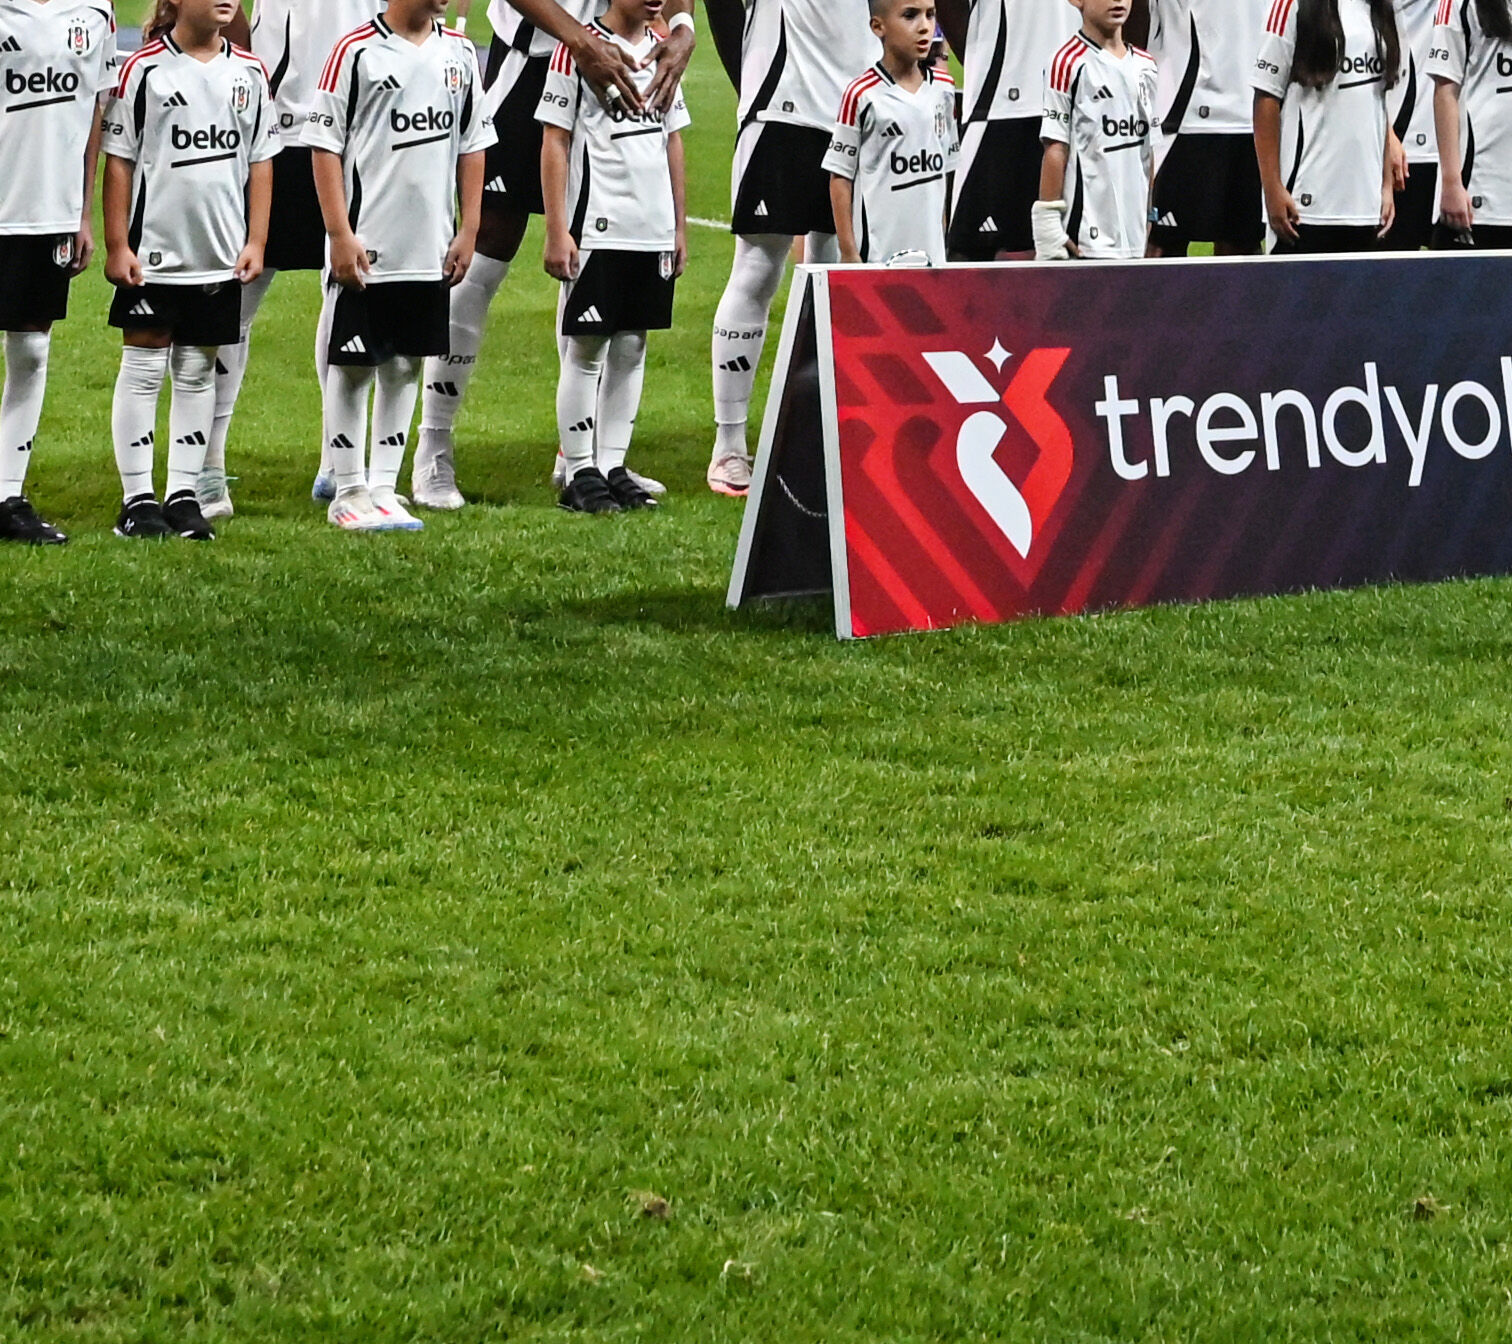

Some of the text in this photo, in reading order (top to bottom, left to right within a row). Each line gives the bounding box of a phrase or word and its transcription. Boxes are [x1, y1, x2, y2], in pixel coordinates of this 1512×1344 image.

[5, 67, 79, 95] beko
[390, 105, 455, 133] beko
[1102, 114, 1148, 138] beko
[171, 123, 241, 150] beko
[890, 149, 944, 175] beko
